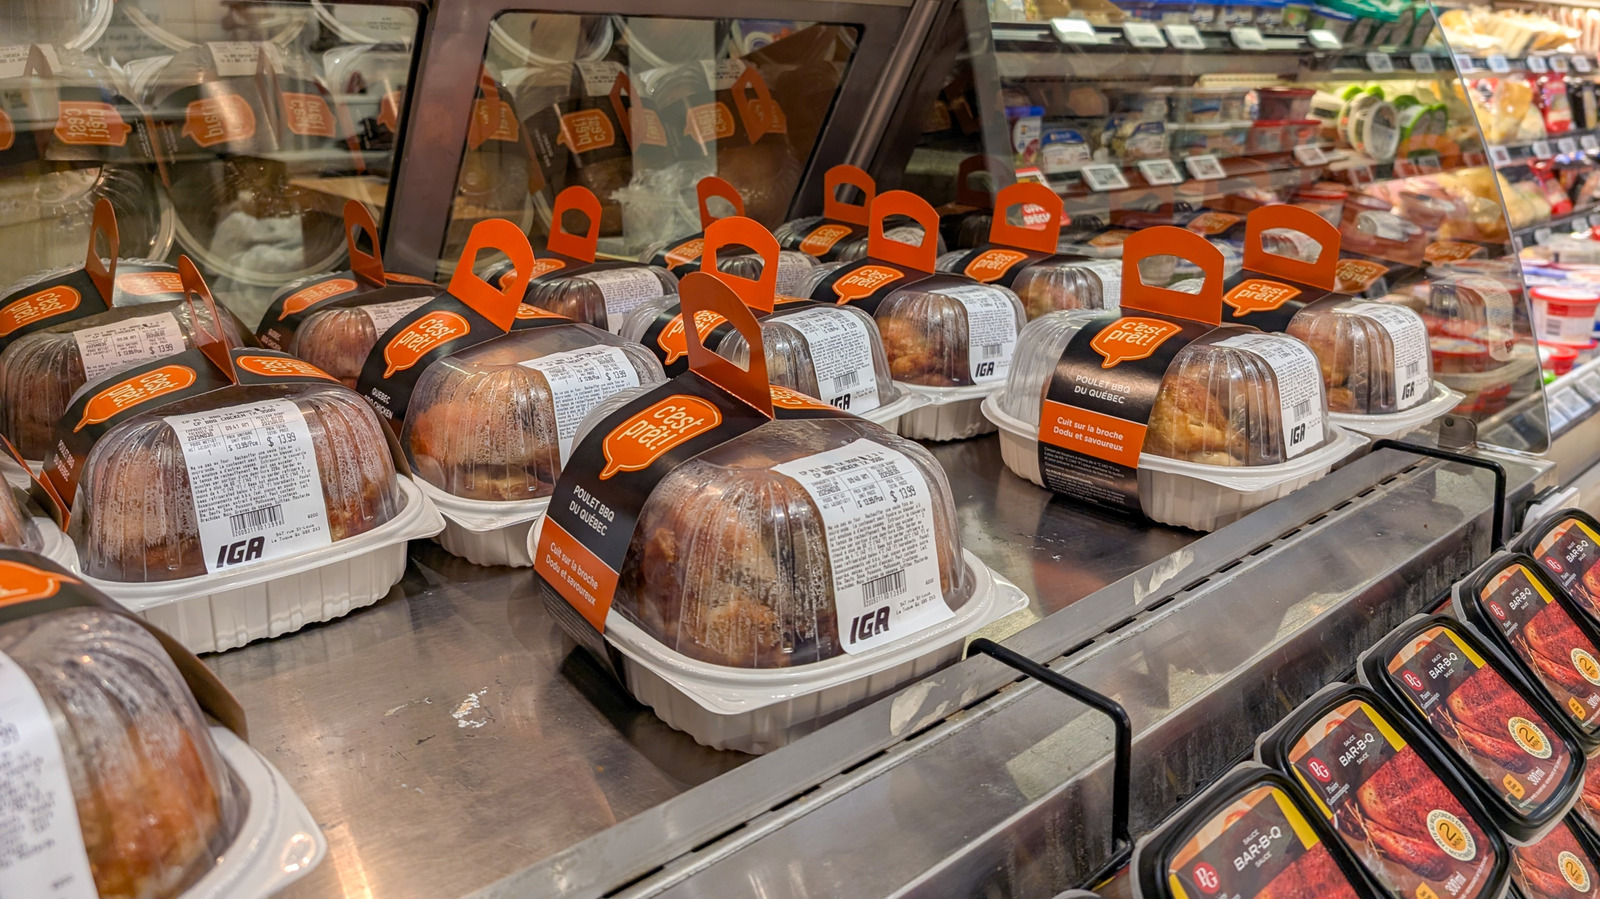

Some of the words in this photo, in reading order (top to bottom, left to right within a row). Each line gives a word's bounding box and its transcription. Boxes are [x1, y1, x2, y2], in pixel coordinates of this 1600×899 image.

[972, 259, 1009, 271] prêt!
[986, 253, 1018, 262] c'est
[842, 275, 881, 288] prêt!
[860, 269, 893, 280] c'est
[1234, 289, 1280, 303] prêt!
[1248, 283, 1288, 296] c'est
[4, 301, 41, 324] prêt!
[36, 292, 68, 314] c'est
[419, 318, 457, 340] c'est
[1103, 330, 1156, 346] prêt!
[1121, 321, 1168, 336] c'est
[157, 343, 173, 353] 13.99
[393, 330, 436, 353] prêt!
[612, 370, 627, 379] 13.99
[975, 362, 994, 377] IGA
[139, 372, 180, 394] c'est
[1076, 375, 1110, 388] POULET
[1112, 382, 1130, 394] BBQ
[1402, 381, 1415, 400] IGA
[99, 383, 147, 409] prêt!
[830, 393, 850, 410] IGA
[1074, 385, 1088, 395] DU
[1089, 389, 1125, 404] QUÉBEC
[653, 406, 704, 434] c'est
[1057, 417, 1072, 427] Cuit
[1074, 421, 1085, 430] sur
[1088, 424, 1094, 433] la
[1096, 426, 1124, 440] broche
[266, 436, 274, 447] $
[277, 432, 296, 445] 13.99
[617, 420, 677, 451] prêt!
[1053, 426, 1073, 438] Dodu
[1084, 435, 1123, 451] savoureux
[1290, 423, 1305, 446] IGA
[573, 485, 600, 510] POULET
[599, 503, 615, 522] BBQ
[889, 489, 898, 503] $
[899, 485, 916, 500] 13.99
[569, 501, 581, 515] DU
[580, 509, 608, 536] QUÉBEC
[216, 536, 265, 568] IGA
[1566, 540, 1589, 563] BAR-B-Q
[550, 542, 562, 558] Cuit
[562, 552, 571, 565] sur
[571, 560, 577, 572] la
[576, 565, 598, 590] broche
[546, 555, 560, 574] Dodu
[561, 570, 567, 582] et
[567, 575, 596, 606] savoureux
[1509, 587, 1532, 610] BAR-B-Q
[849, 606, 890, 645] IGA
[1428, 652, 1458, 679] BAR-B-Q
[1580, 657, 1592, 671] 2
[1343, 734, 1357, 747] SAUCE
[1519, 727, 1534, 743] 2
[1339, 732, 1375, 767] BAR-B-Q
[1356, 752, 1370, 765] SAUCE
[1243, 829, 1260, 845] SAUCE
[1440, 822, 1457, 842] 2
[1233, 826, 1282, 871] BAR-B-Q
[1254, 850, 1273, 868] SAUCE
[1565, 861, 1578, 877] 2
